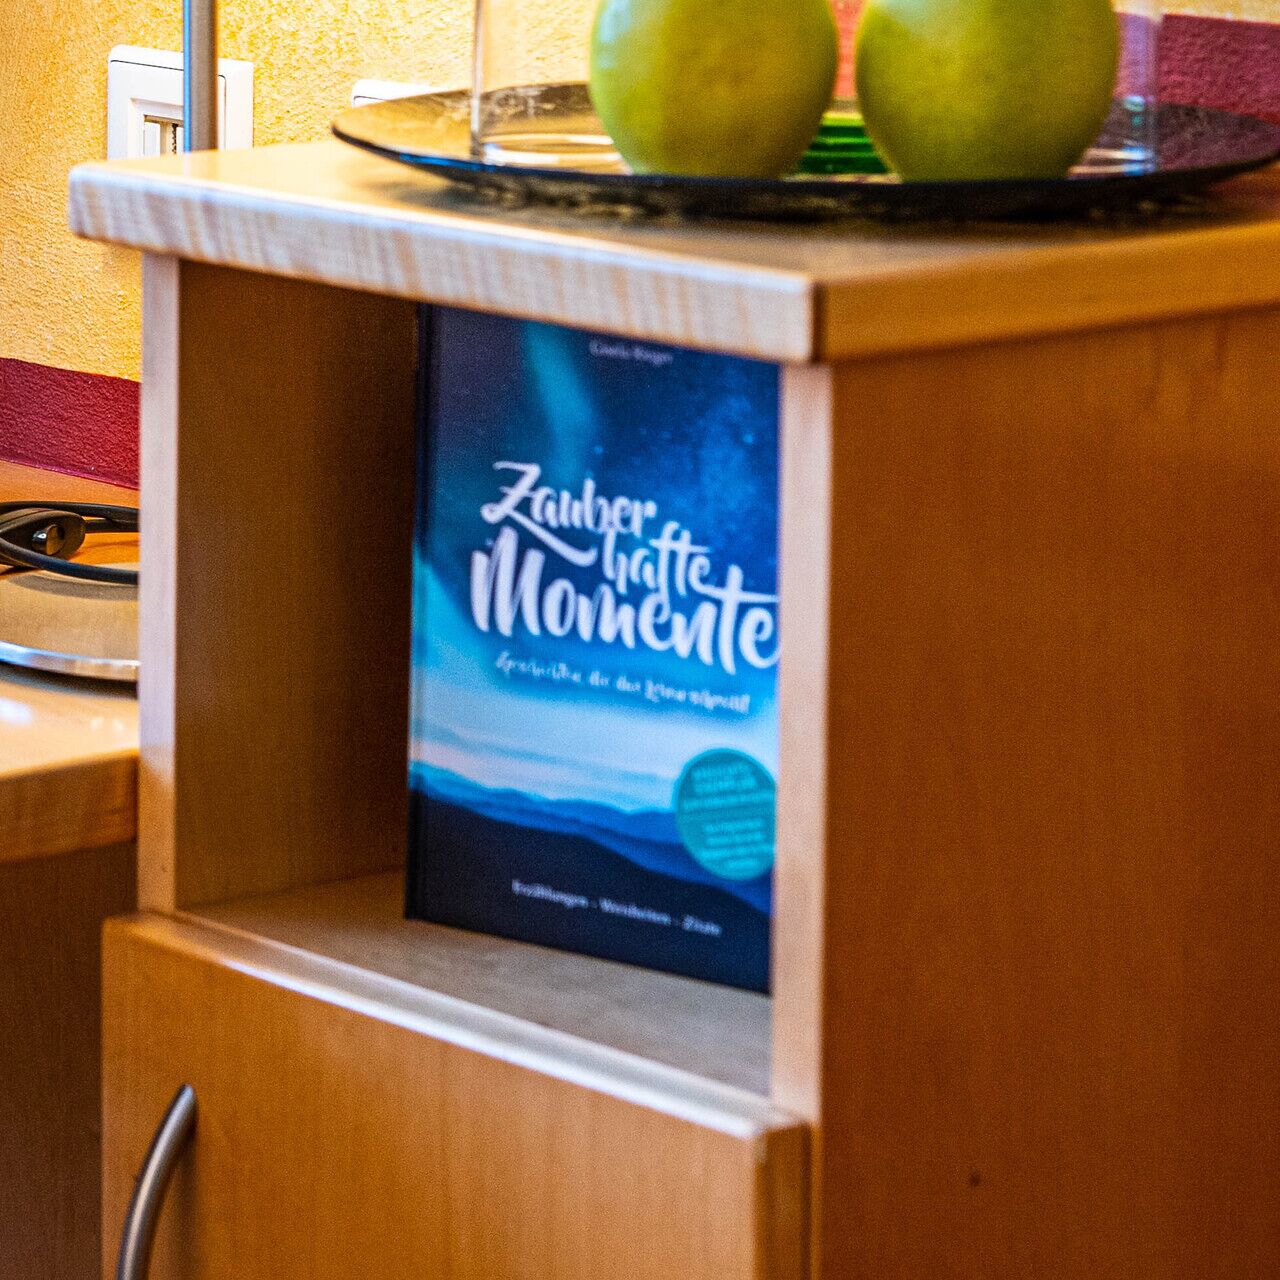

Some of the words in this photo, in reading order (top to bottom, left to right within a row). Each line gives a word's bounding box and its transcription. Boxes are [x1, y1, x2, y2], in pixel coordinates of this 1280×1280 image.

[480, 461, 657, 568] Zauber
[470, 525, 781, 676] Momente
[603, 521, 711, 620] hafte
